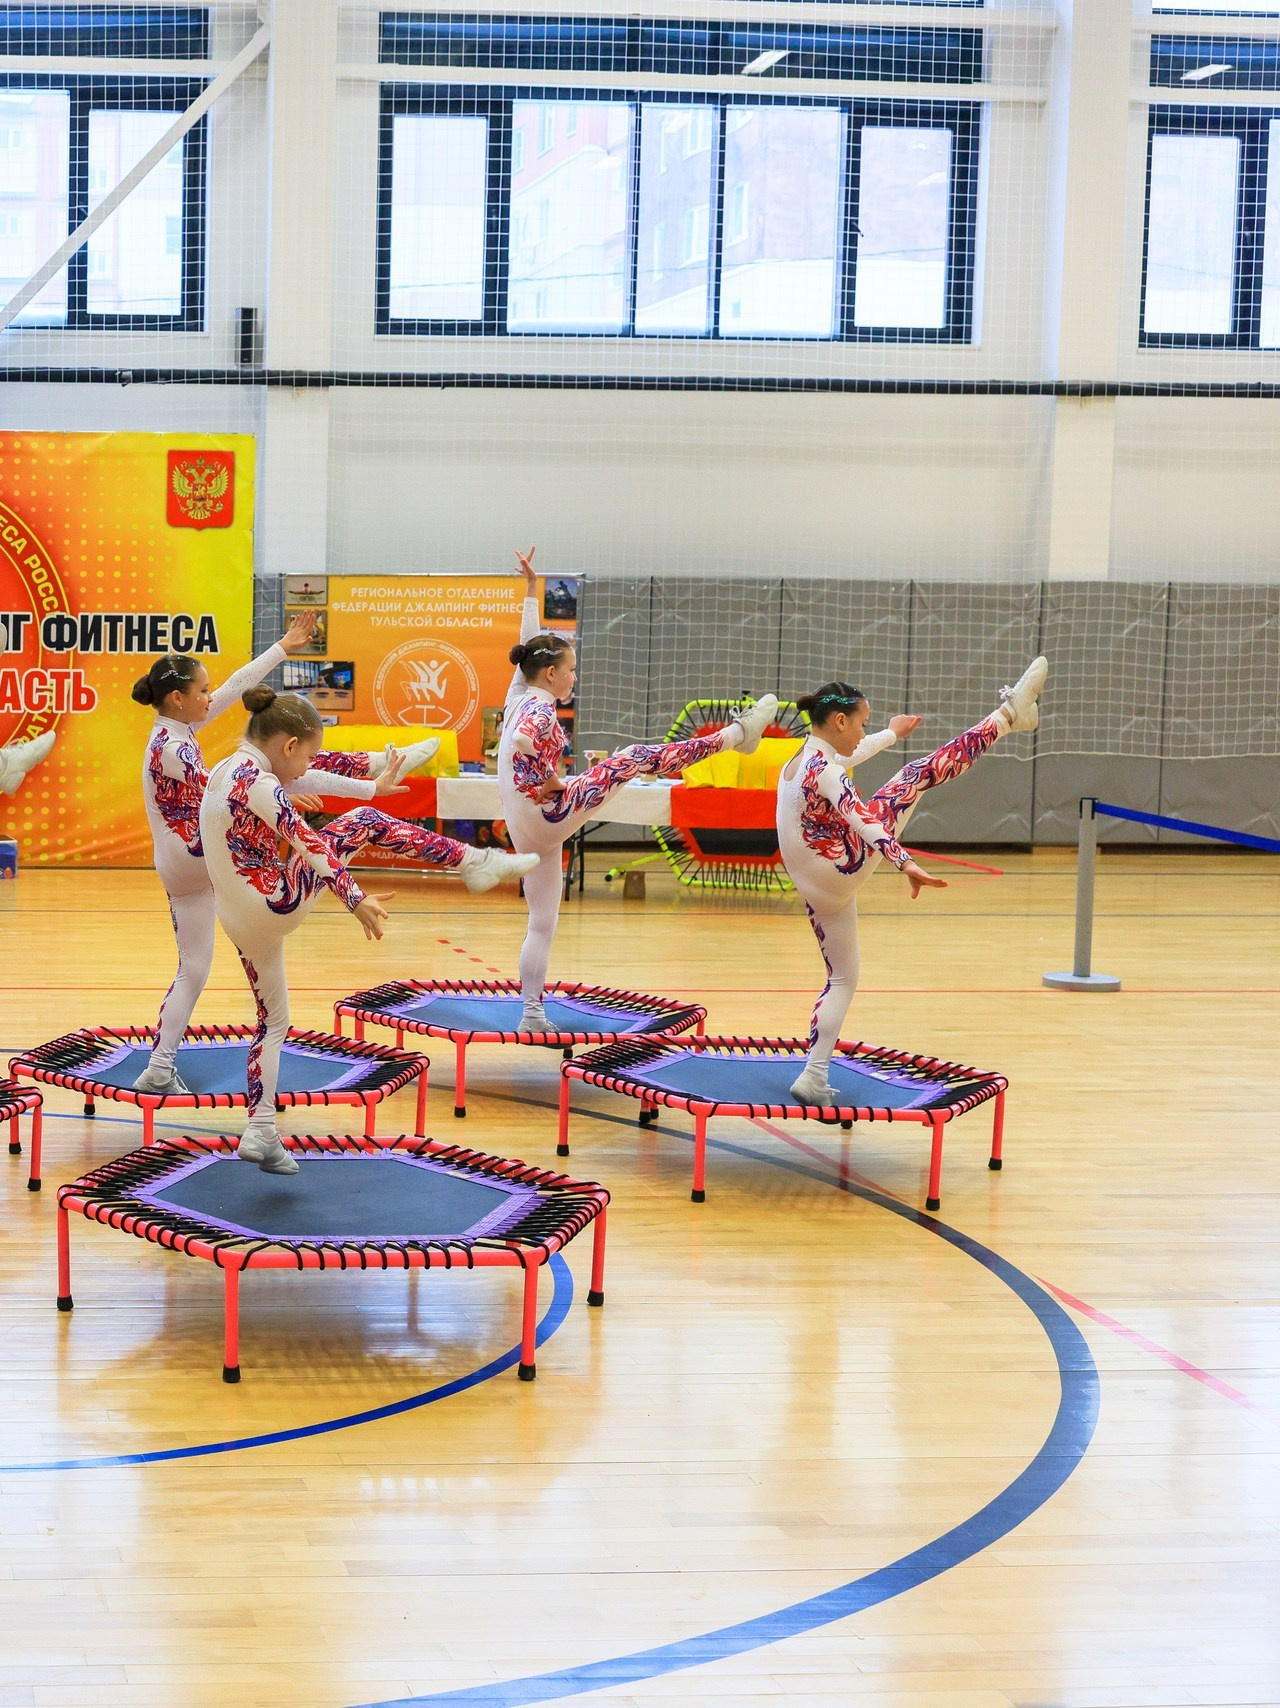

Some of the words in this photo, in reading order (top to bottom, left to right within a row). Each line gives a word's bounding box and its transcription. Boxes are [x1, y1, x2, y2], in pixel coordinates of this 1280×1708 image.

[23, 553, 60, 617] РОСС
[351, 587, 443, 598] РЕГИОНАЛЬНОЕ
[446, 588, 515, 600] ОТДЕЛЕНИЕ
[331, 602, 402, 613] ФЕДЕРАЦИИ
[404, 602, 477, 613] ДЖАМПИНГ
[478, 603, 524, 614] ФИТНЕС
[371, 615, 432, 627] ТУЛЬСКОЙ
[436, 616, 493, 627] ОБЛАСТИ
[41, 611, 220, 655] ФИТНЕСА
